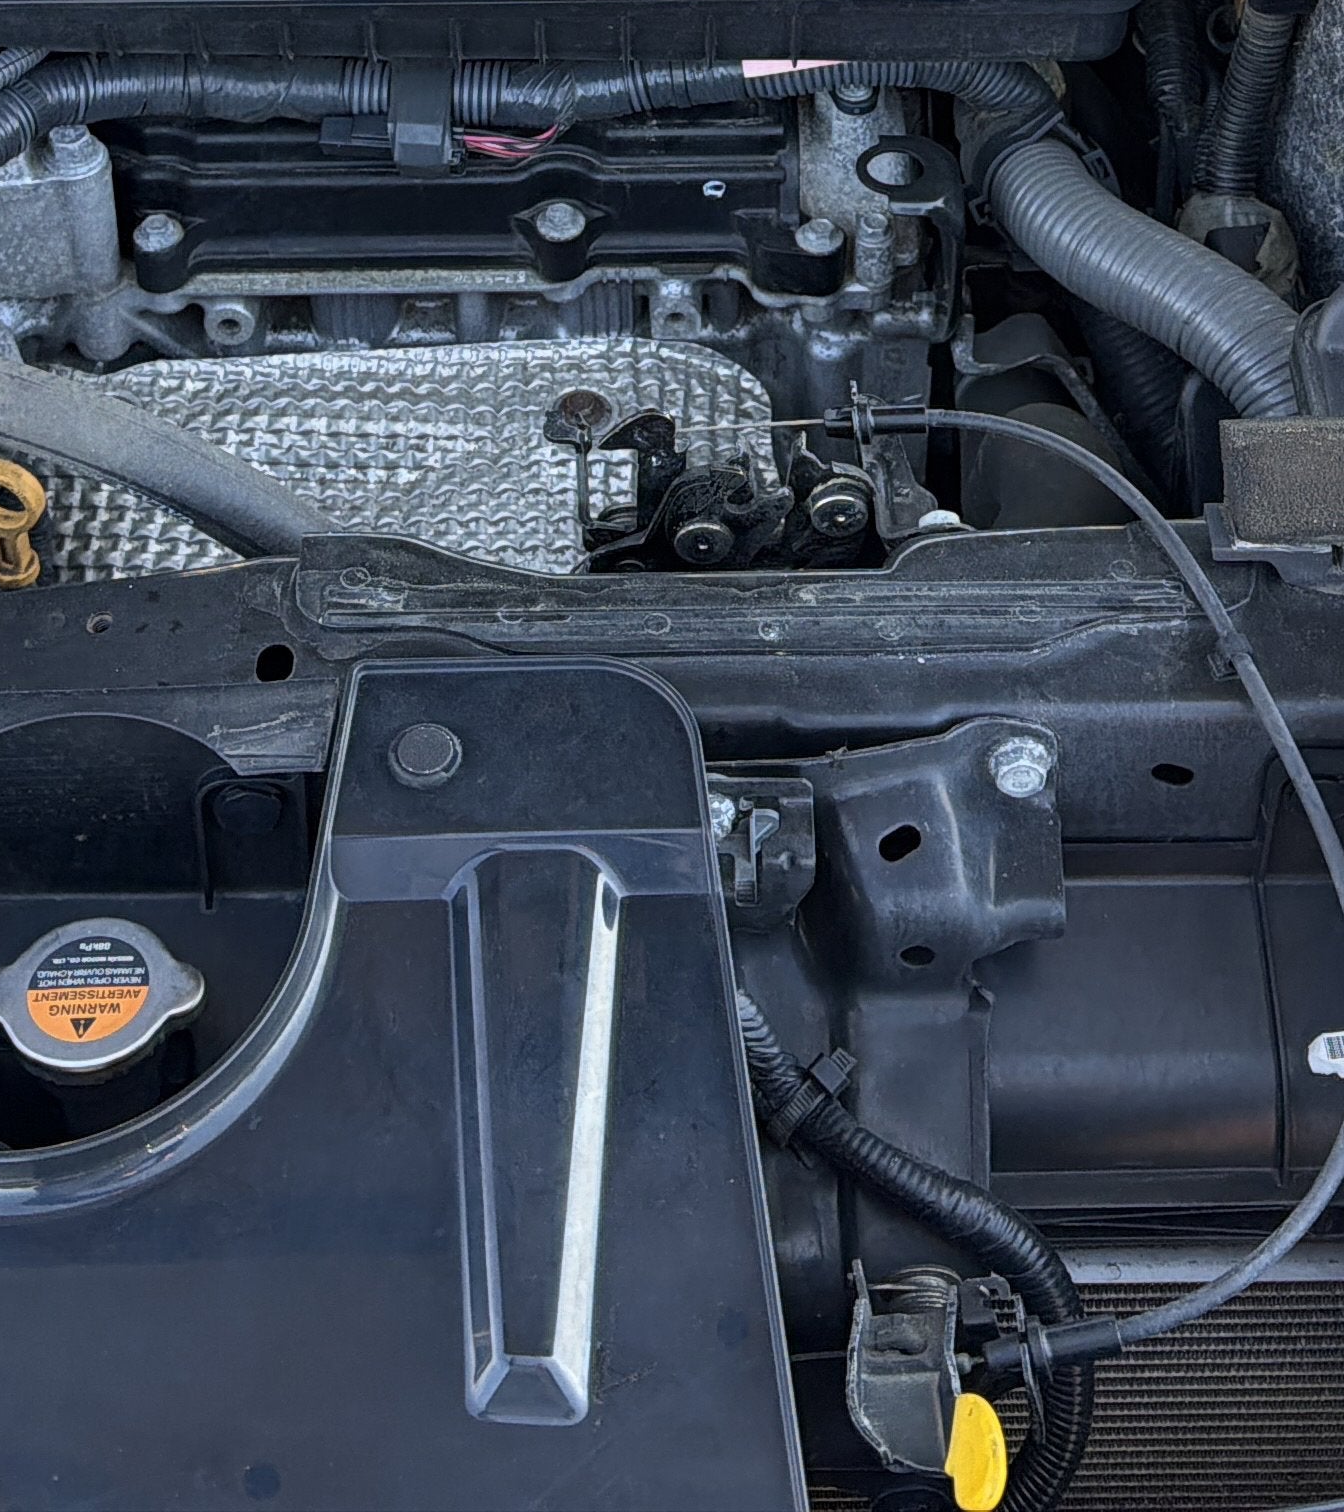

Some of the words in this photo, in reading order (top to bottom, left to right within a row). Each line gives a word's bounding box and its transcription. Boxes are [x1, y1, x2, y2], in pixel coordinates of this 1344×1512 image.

[133, 967, 145, 975] NE
[58, 978, 85, 986] WHEN
[87, 977, 112, 985] OPEN
[112, 976, 142, 984] NEVER
[32, 988, 142, 1002] AVERTISSEMENT
[48, 1002, 121, 1016] WARNING
